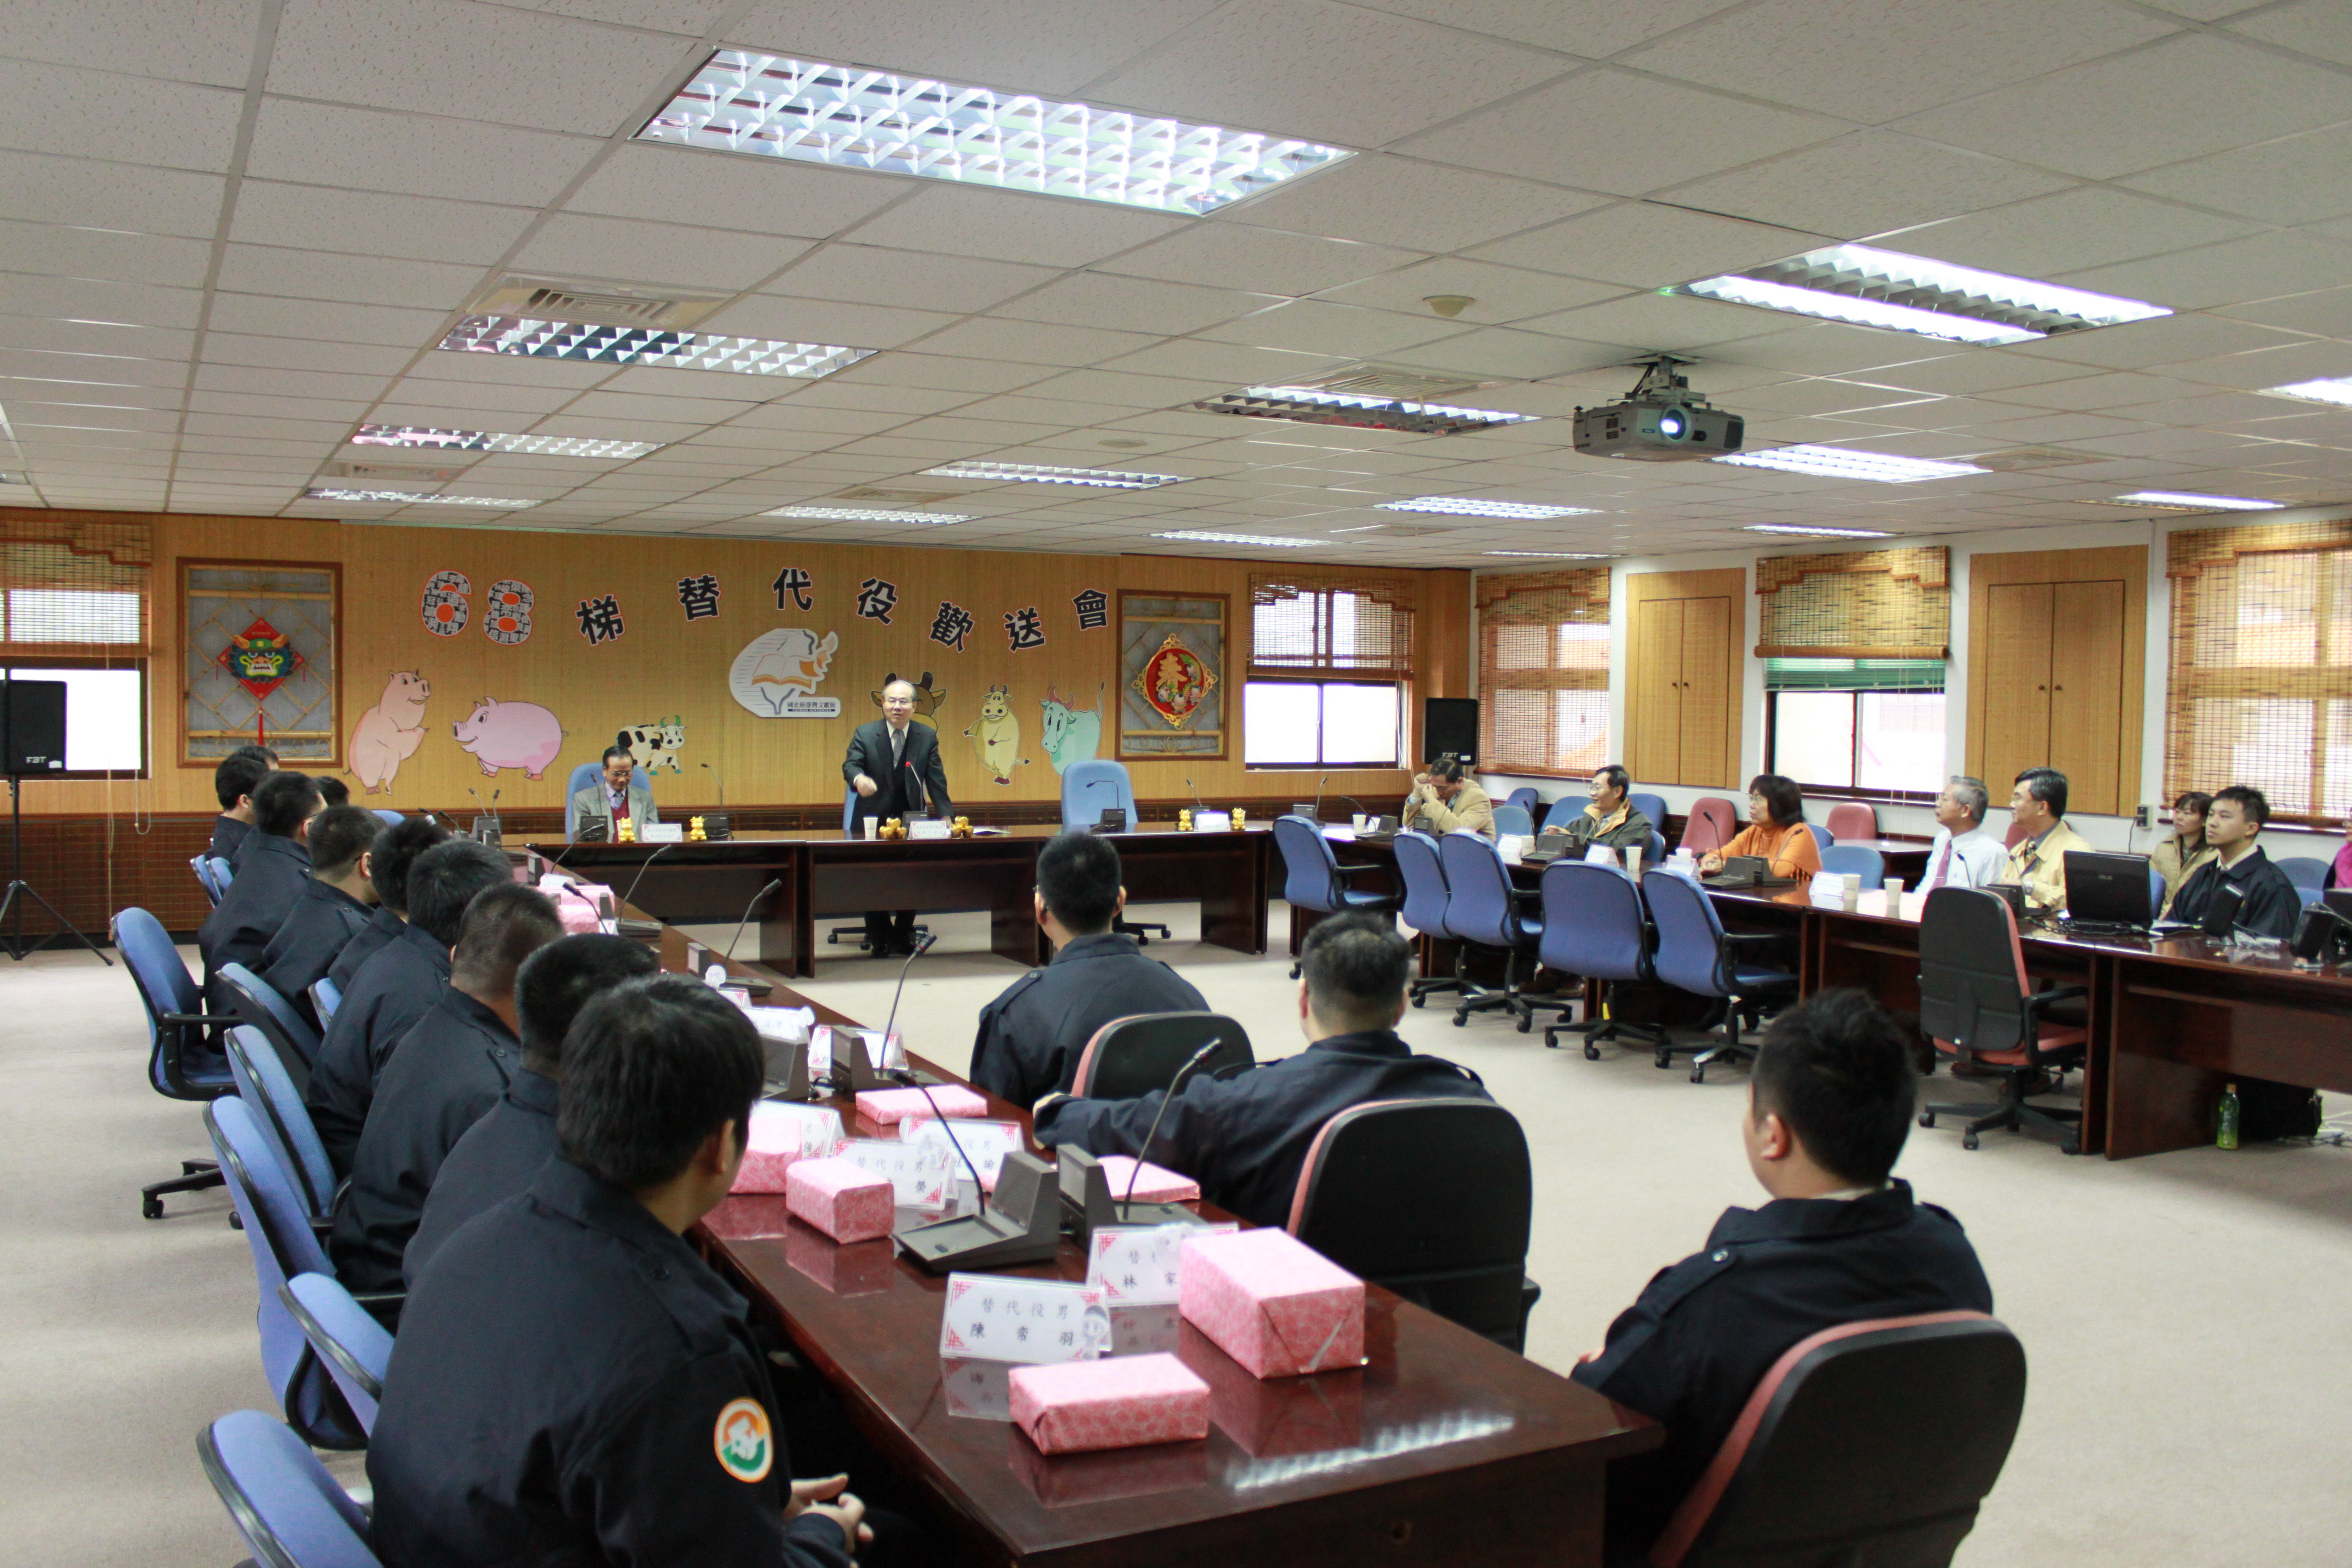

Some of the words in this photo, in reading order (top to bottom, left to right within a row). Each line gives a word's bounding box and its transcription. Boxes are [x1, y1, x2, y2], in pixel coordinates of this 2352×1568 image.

[858, 1156, 923, 1173] 替代役男
[982, 1298, 1068, 1320] 替代役男
